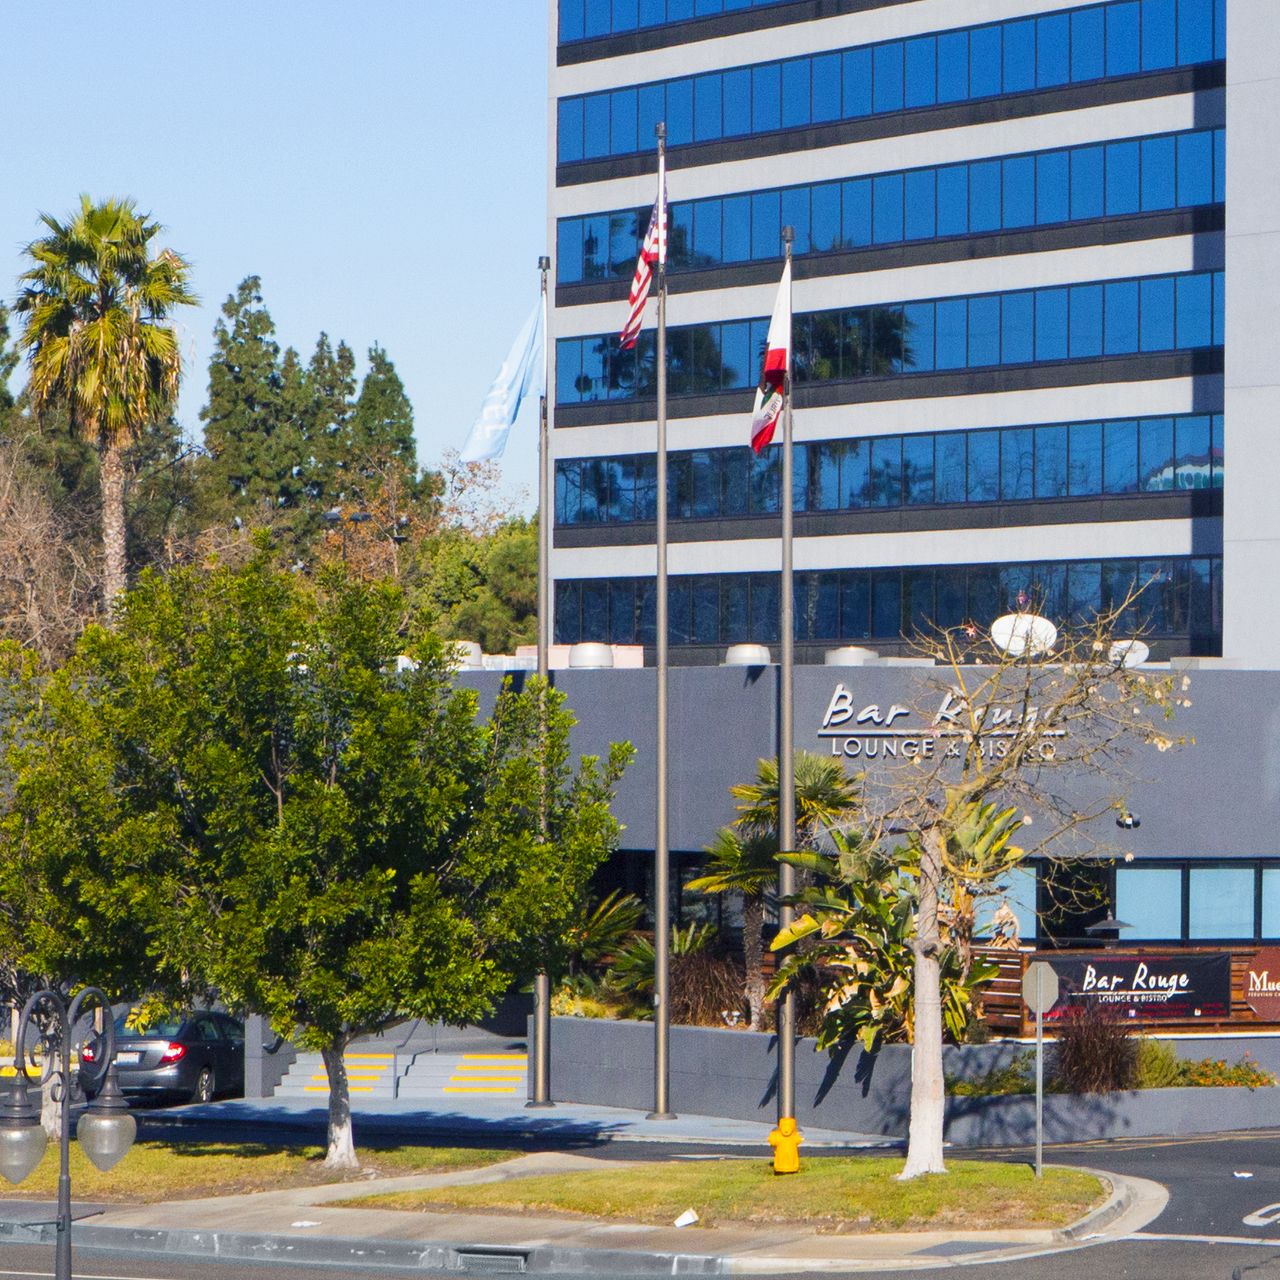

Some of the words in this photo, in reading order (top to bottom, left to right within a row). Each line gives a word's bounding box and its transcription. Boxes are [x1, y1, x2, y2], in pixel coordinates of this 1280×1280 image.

[822, 683, 910, 729] Bar
[832, 737, 935, 758] LOUNGE
[973, 738, 1057, 759] BISRO
[1082, 964, 1124, 992] Bar
[1132, 962, 1190, 998] Rouge
